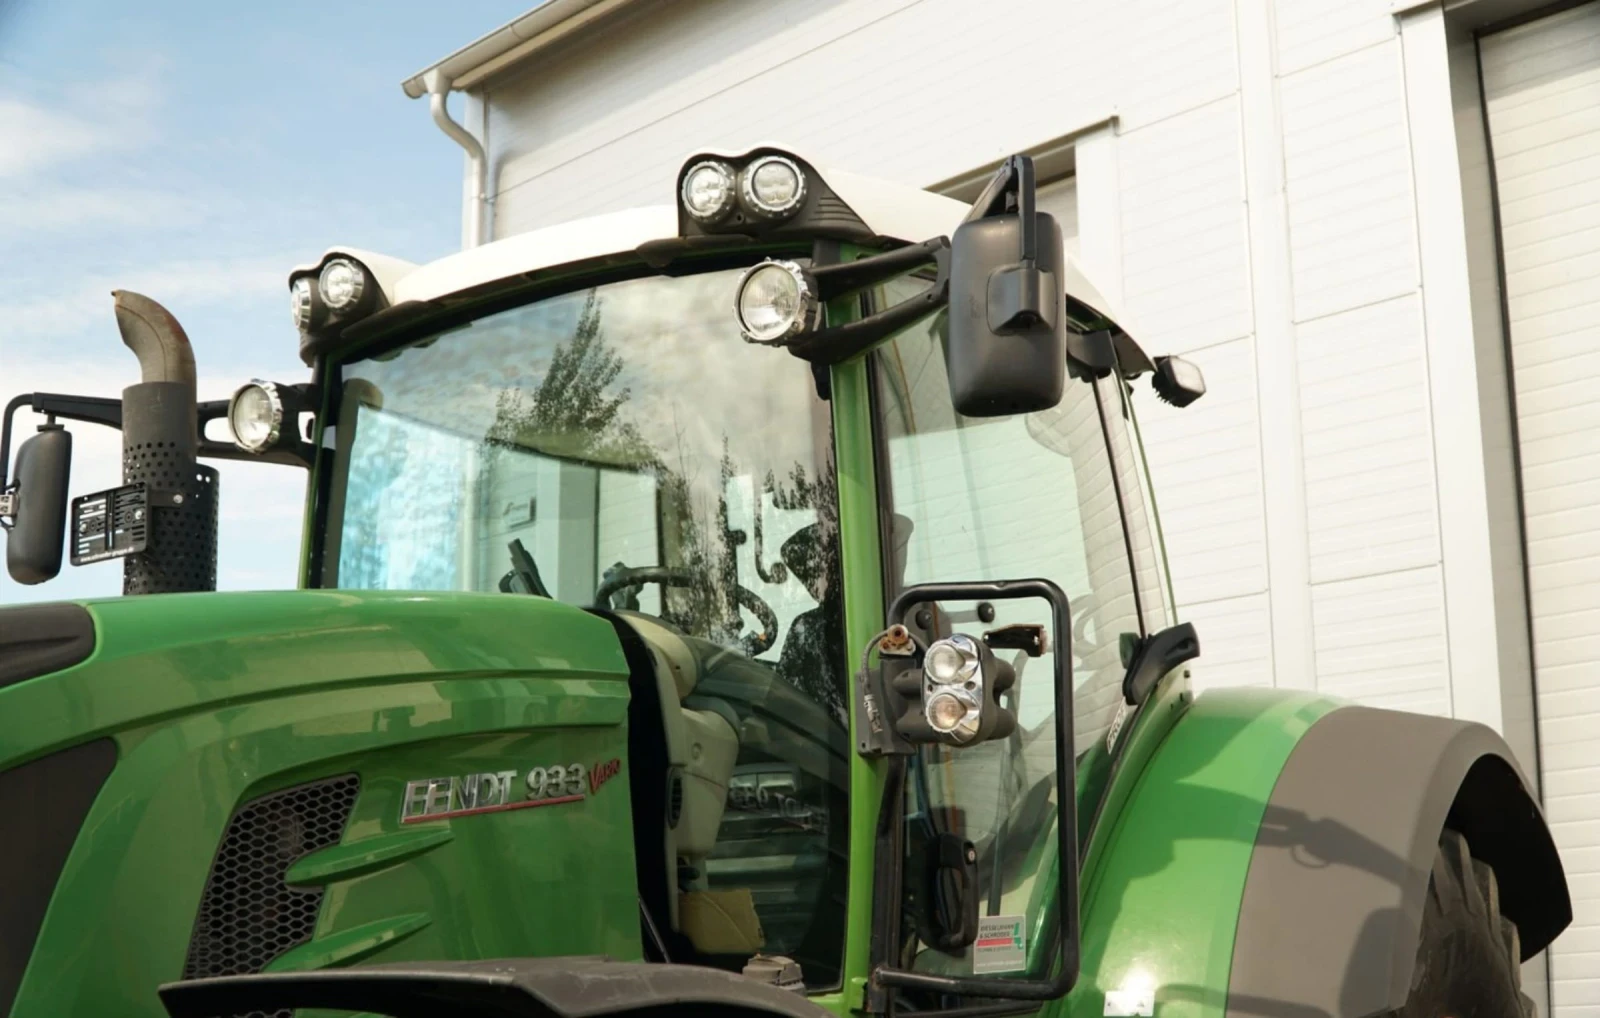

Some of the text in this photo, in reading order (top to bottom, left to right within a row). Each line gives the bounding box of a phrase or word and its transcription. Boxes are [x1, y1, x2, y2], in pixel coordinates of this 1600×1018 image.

[401, 758, 621, 824] FENDT 933 VARIO
